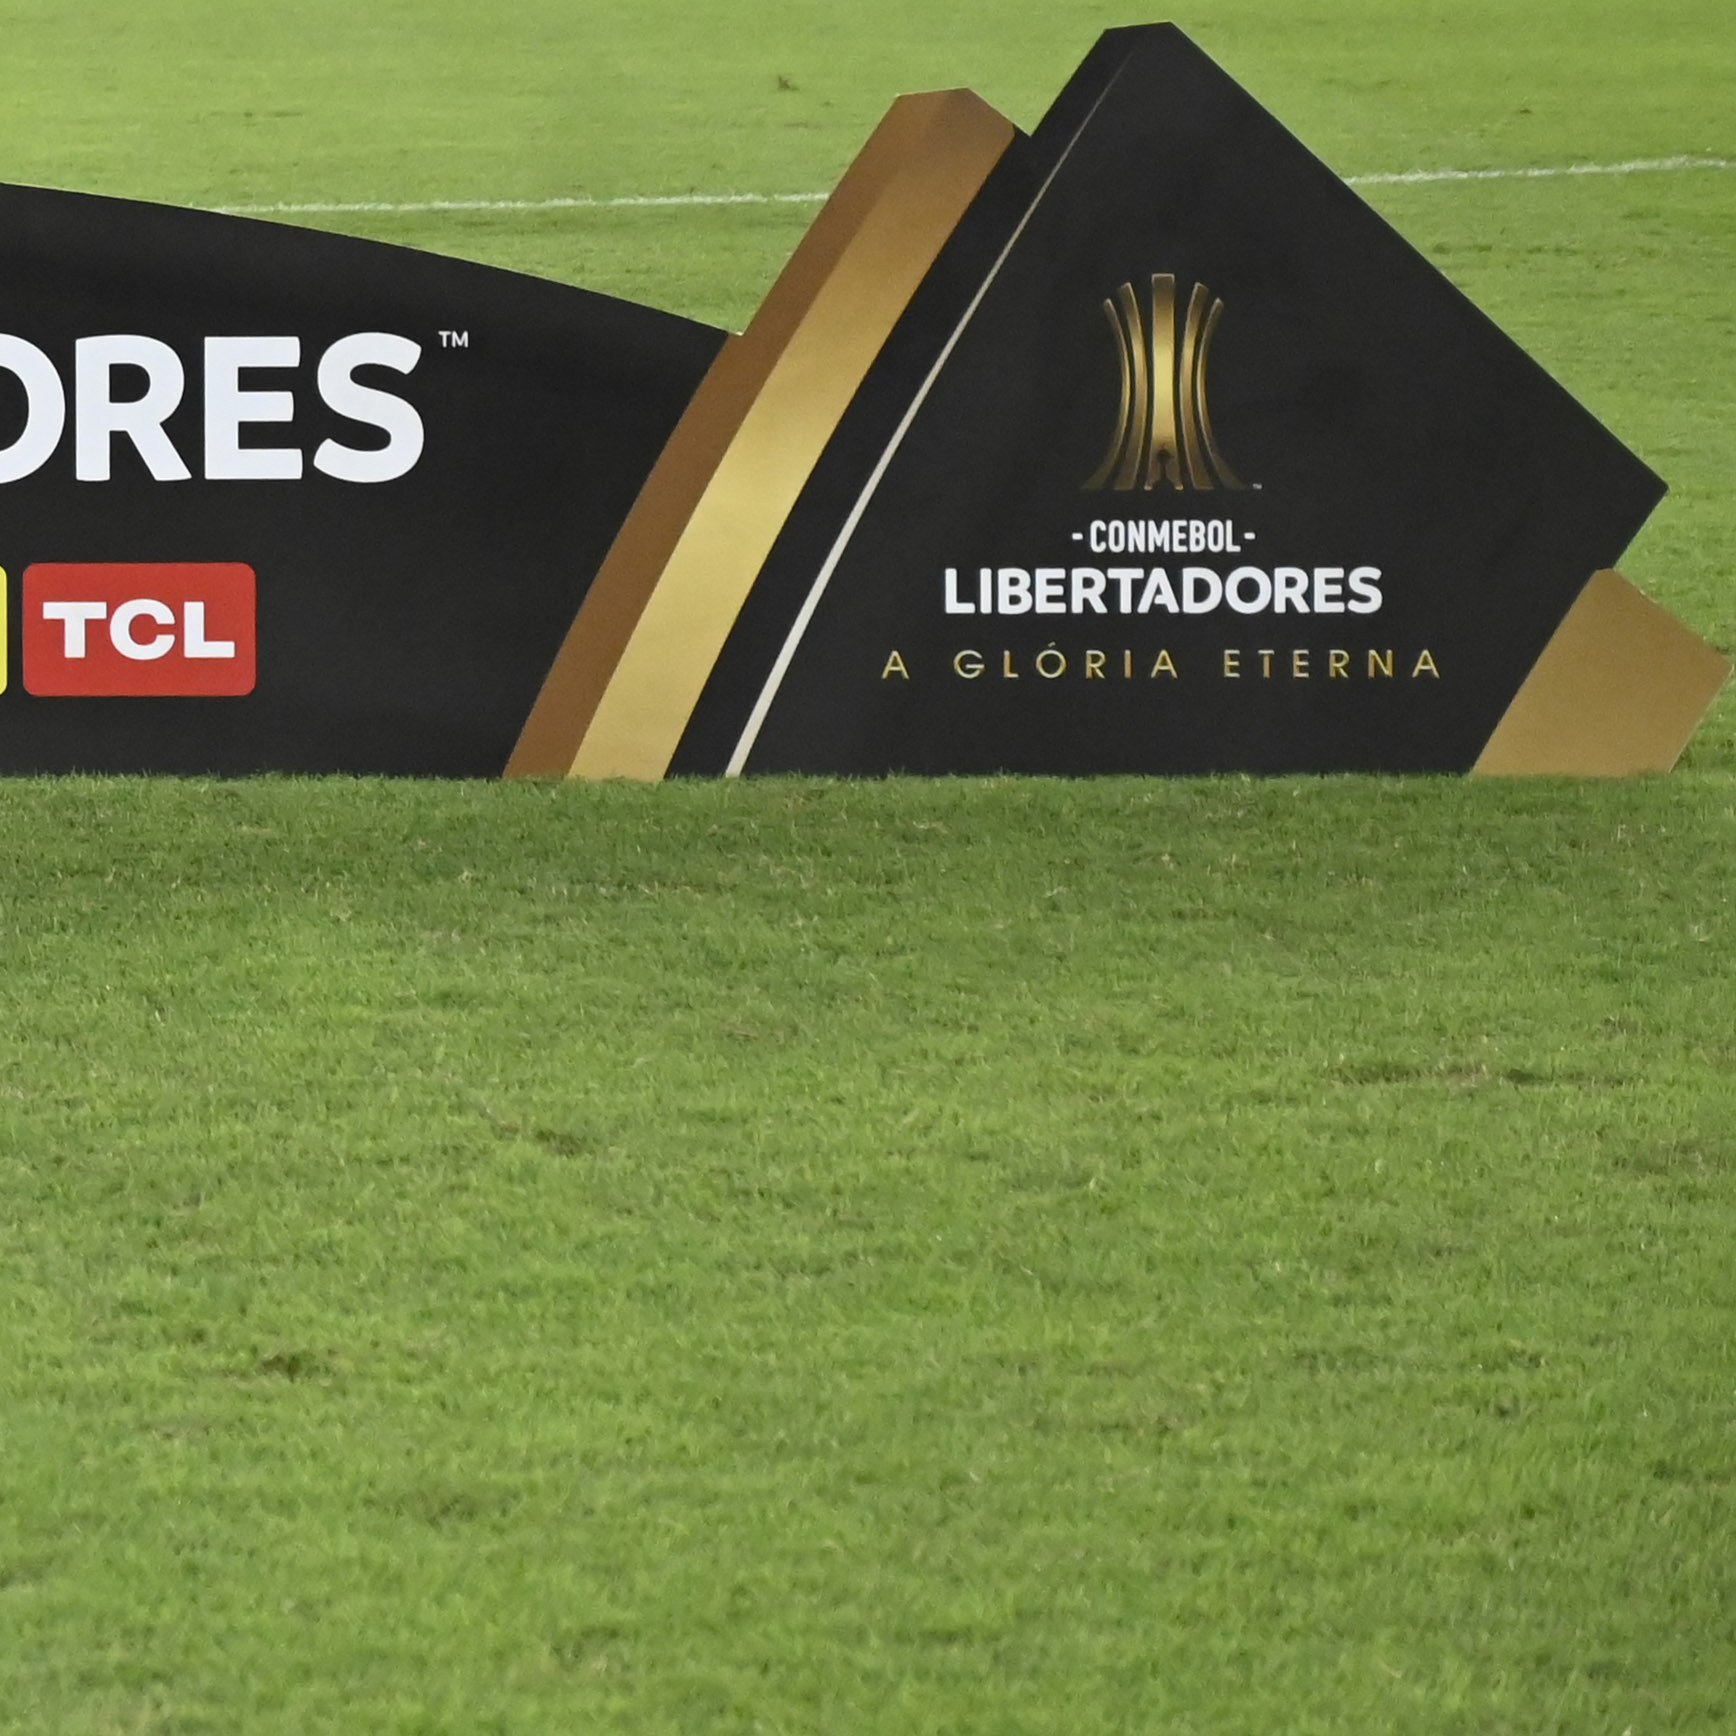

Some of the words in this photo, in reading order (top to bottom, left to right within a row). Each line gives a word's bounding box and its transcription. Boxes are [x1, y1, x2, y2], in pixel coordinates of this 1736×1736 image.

[944, 566, 1384, 616] LIBERTADORES
[42, 598, 236, 662] TCL
[883, 652, 909, 679] A
[953, 642, 1179, 680] GLÓRIA
[1222, 649, 1442, 680] ETERNA
